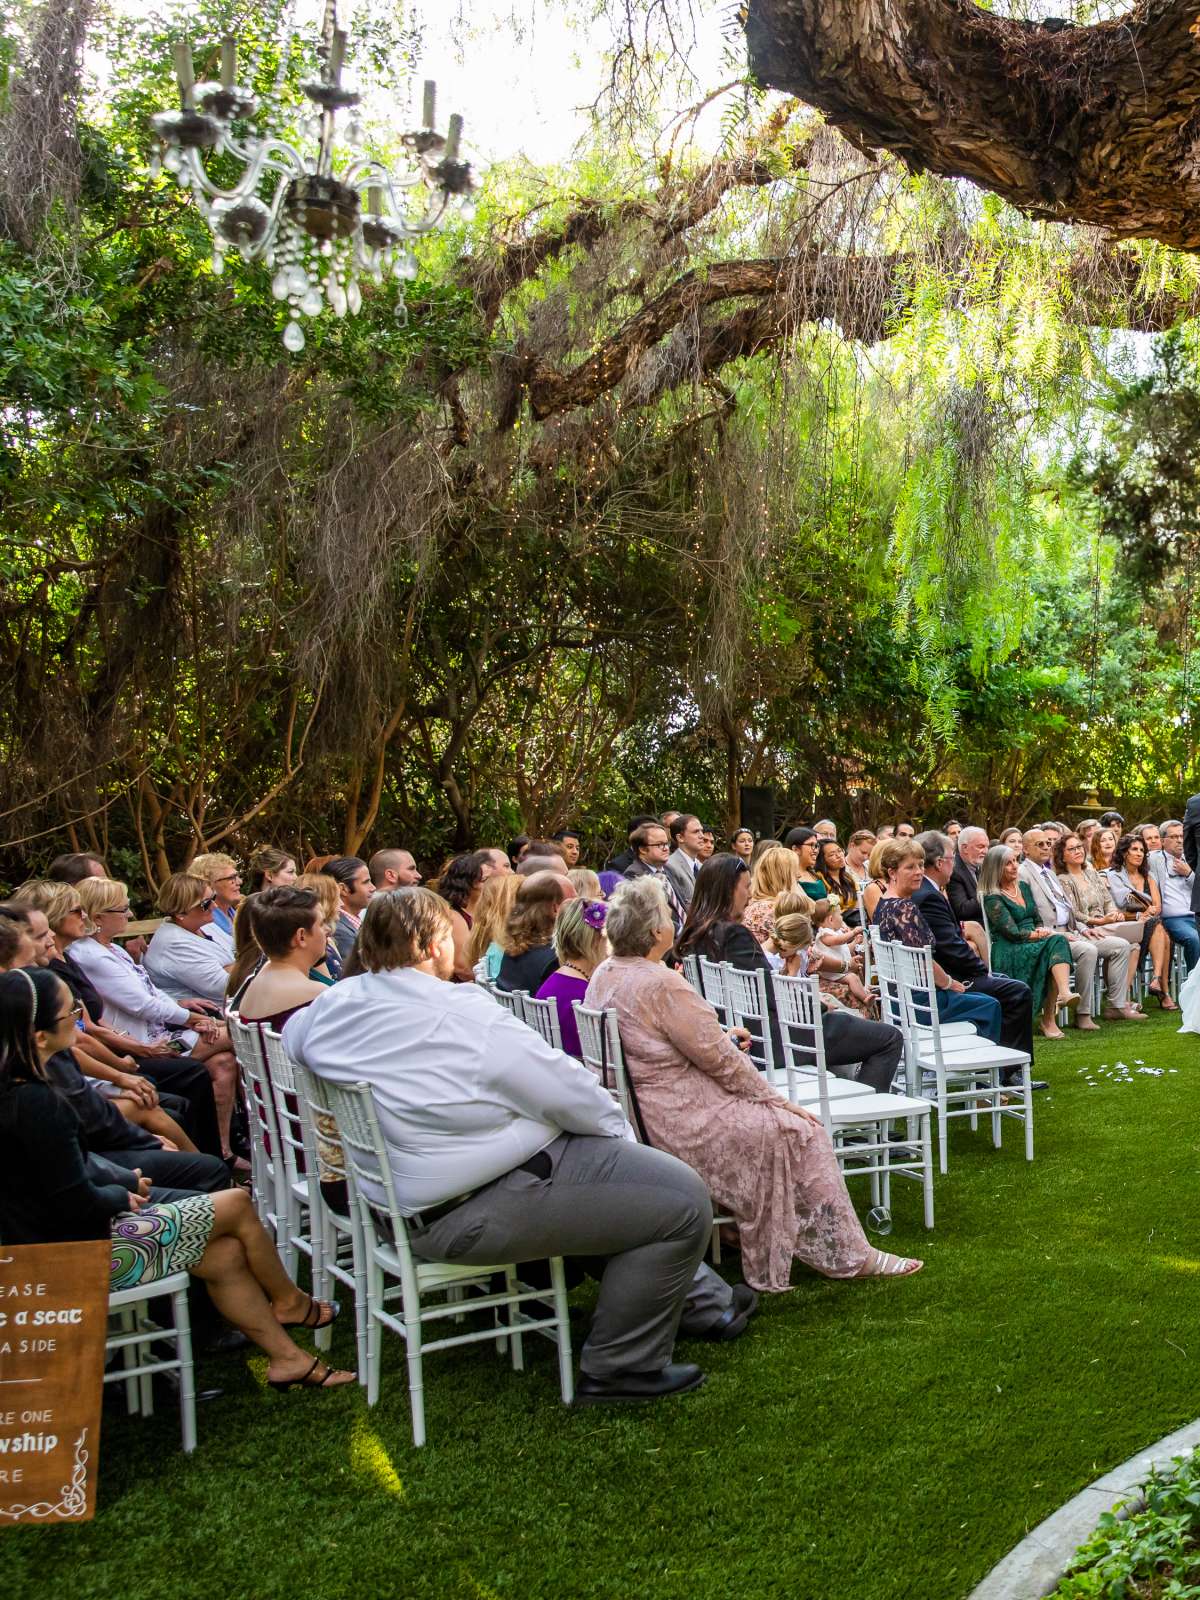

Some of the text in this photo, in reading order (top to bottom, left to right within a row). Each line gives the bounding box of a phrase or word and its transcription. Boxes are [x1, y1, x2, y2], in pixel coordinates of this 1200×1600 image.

[15, 1310, 29, 1326] a
[19, 1339, 57, 1353] SIDE
[21, 1409, 53, 1424] ONE
